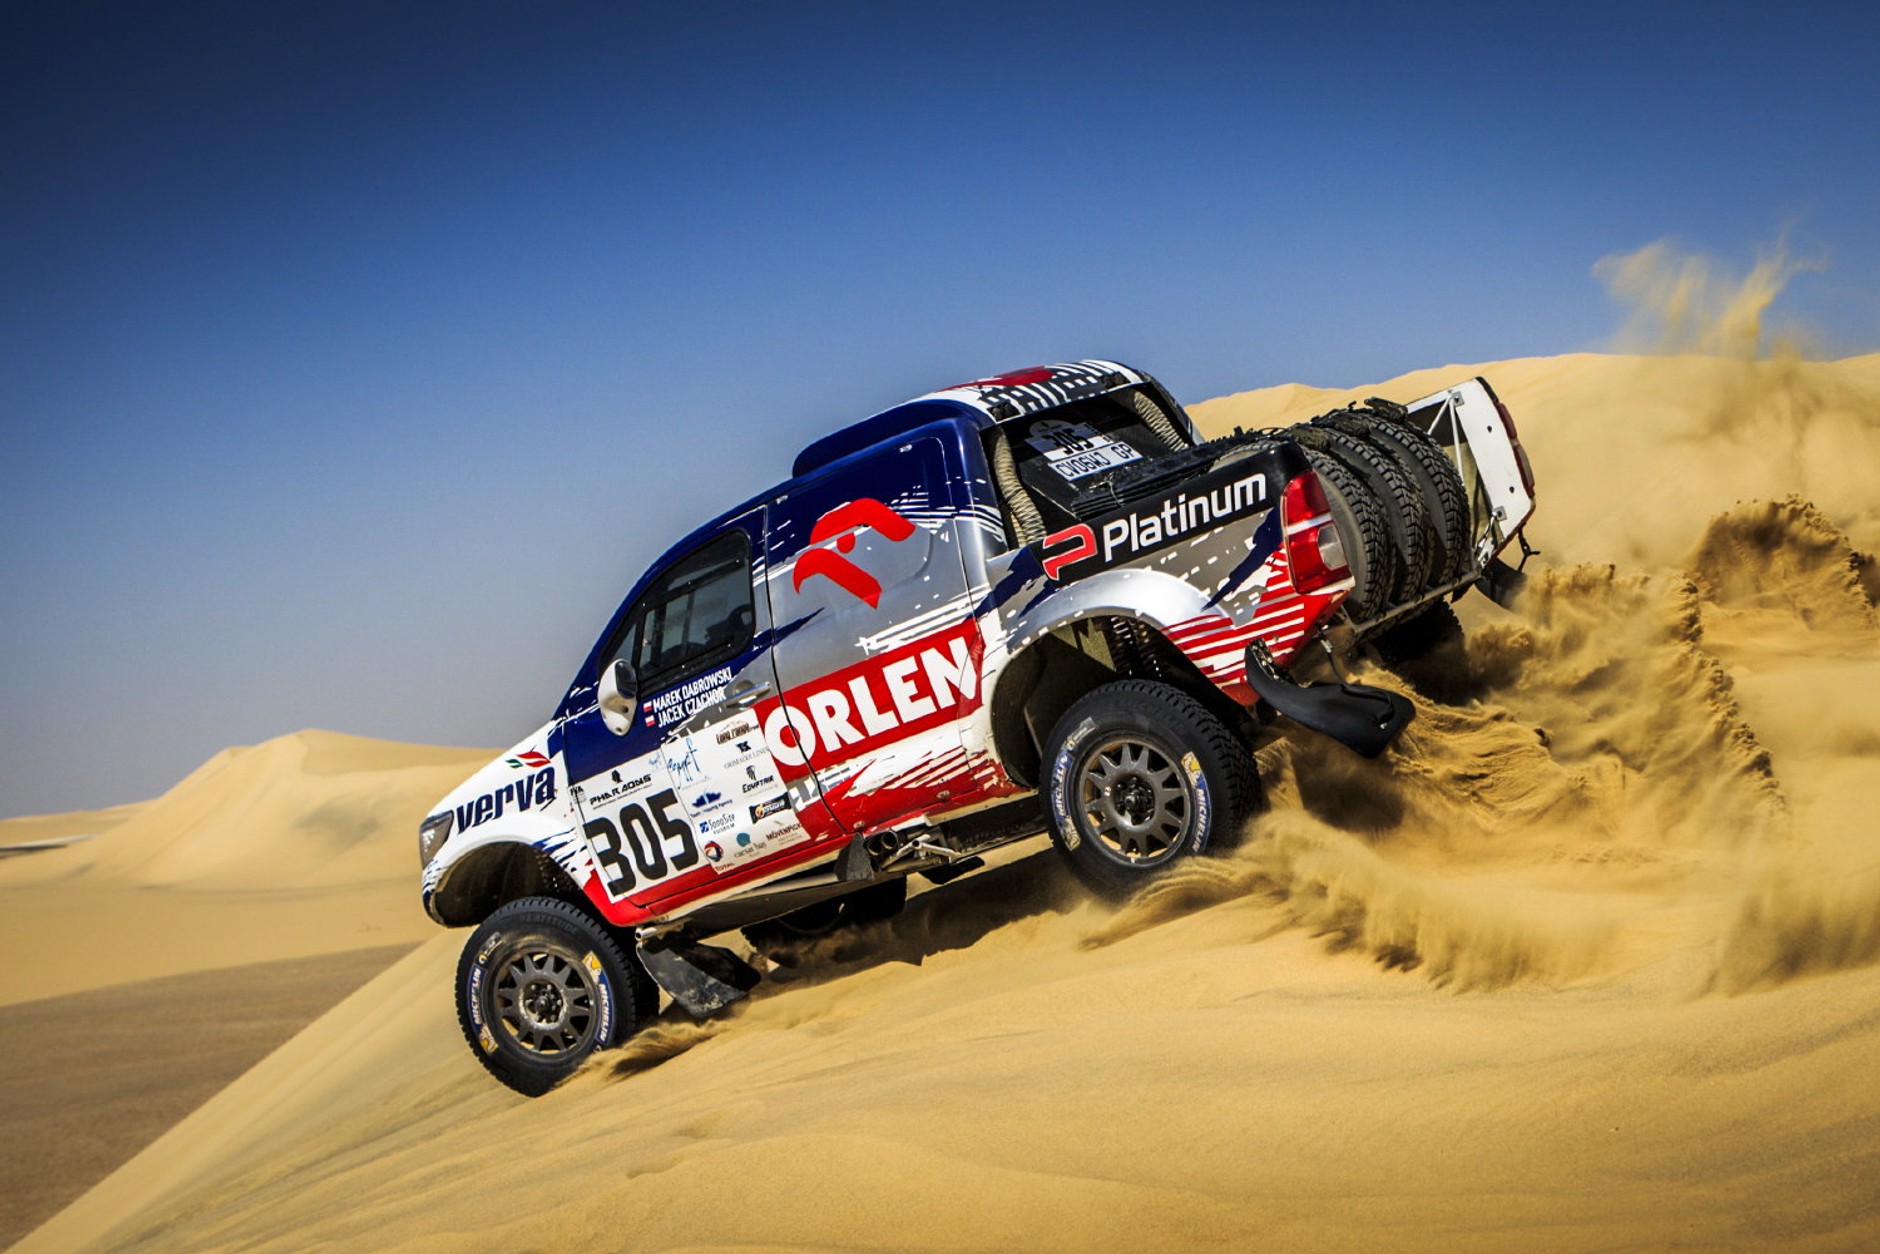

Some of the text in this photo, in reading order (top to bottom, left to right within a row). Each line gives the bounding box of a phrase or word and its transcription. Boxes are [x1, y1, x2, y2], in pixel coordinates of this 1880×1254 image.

[1042, 427, 1094, 455] 305
[1111, 443, 1135, 460] GP
[1103, 473, 1267, 563] Platinum
[653, 688, 682, 713] MAREK
[658, 703, 686, 728] JACEK
[764, 636, 977, 766] ORLEN
[456, 767, 556, 834] verva
[1192, 788, 1206, 852] MICHELIN
[583, 788, 699, 897] 305
[599, 983, 611, 1042] MICHELIN
